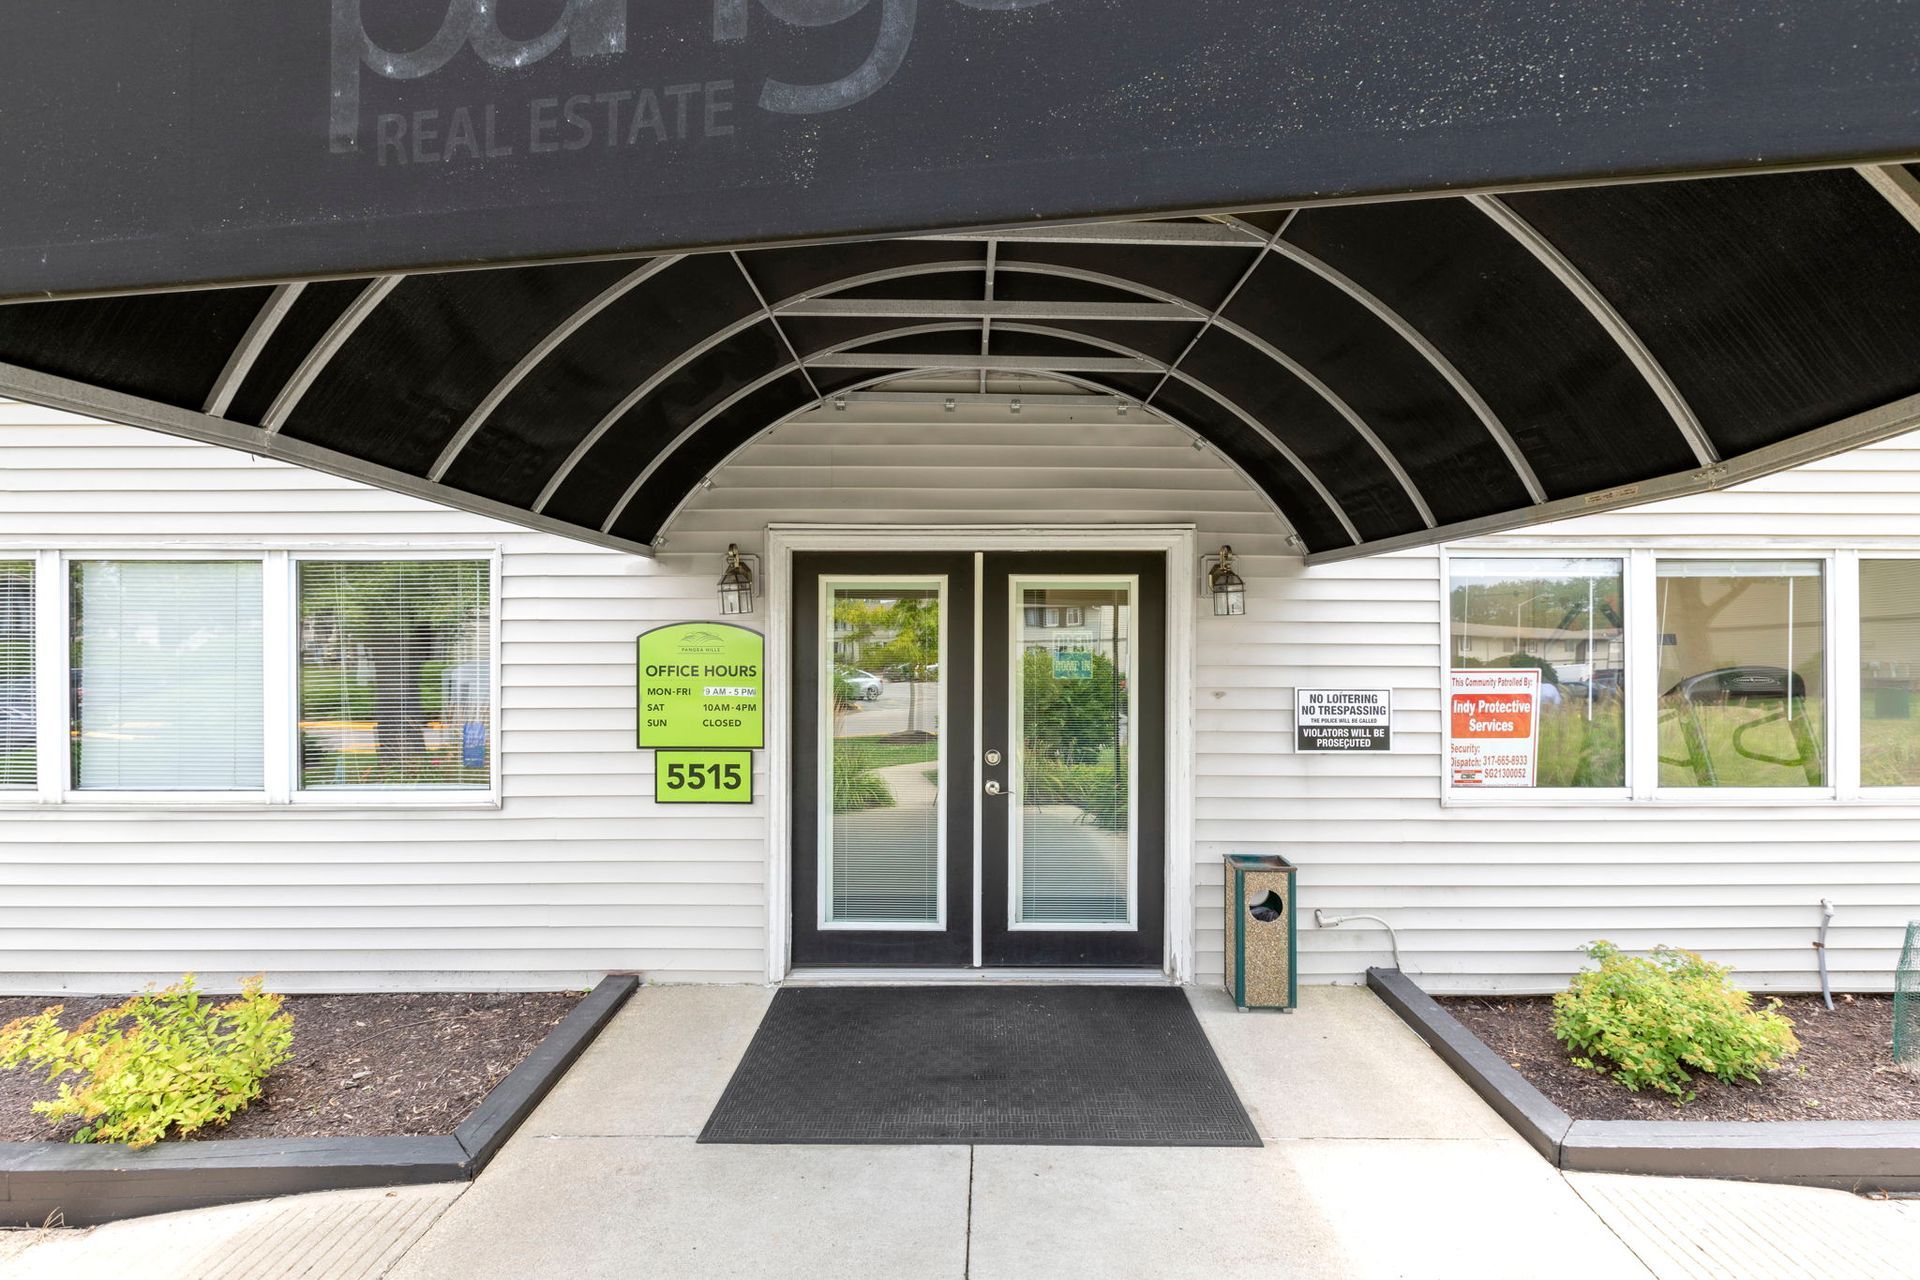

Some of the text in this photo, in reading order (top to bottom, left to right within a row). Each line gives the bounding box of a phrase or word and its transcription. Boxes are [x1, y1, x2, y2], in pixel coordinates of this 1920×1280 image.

[375, 78, 736, 167] REAL ESTATE
[645, 665, 757, 677] OFFICE HOURS
[1452, 677, 1532, 689] This Community Patrolled By:
[1309, 694, 1378, 704] NO LOITERING
[647, 703, 665, 712] SAT
[1301, 705, 1387, 715] NO TRESPASSING
[1453, 699, 1531, 716] Indy Protective
[647, 719, 667, 727] SUN
[703, 719, 742, 727] CLOSED
[1469, 718, 1514, 732] Services
[1303, 729, 1385, 737] VIOLATORS WILL BE
[1317, 738, 1371, 748] PROSECUTED
[1451, 743, 1480, 755] Security:
[1483, 755, 1528, 766] 317-665-8933
[666, 763, 742, 790] 5515
[1484, 768, 1526, 778] SG21300052
